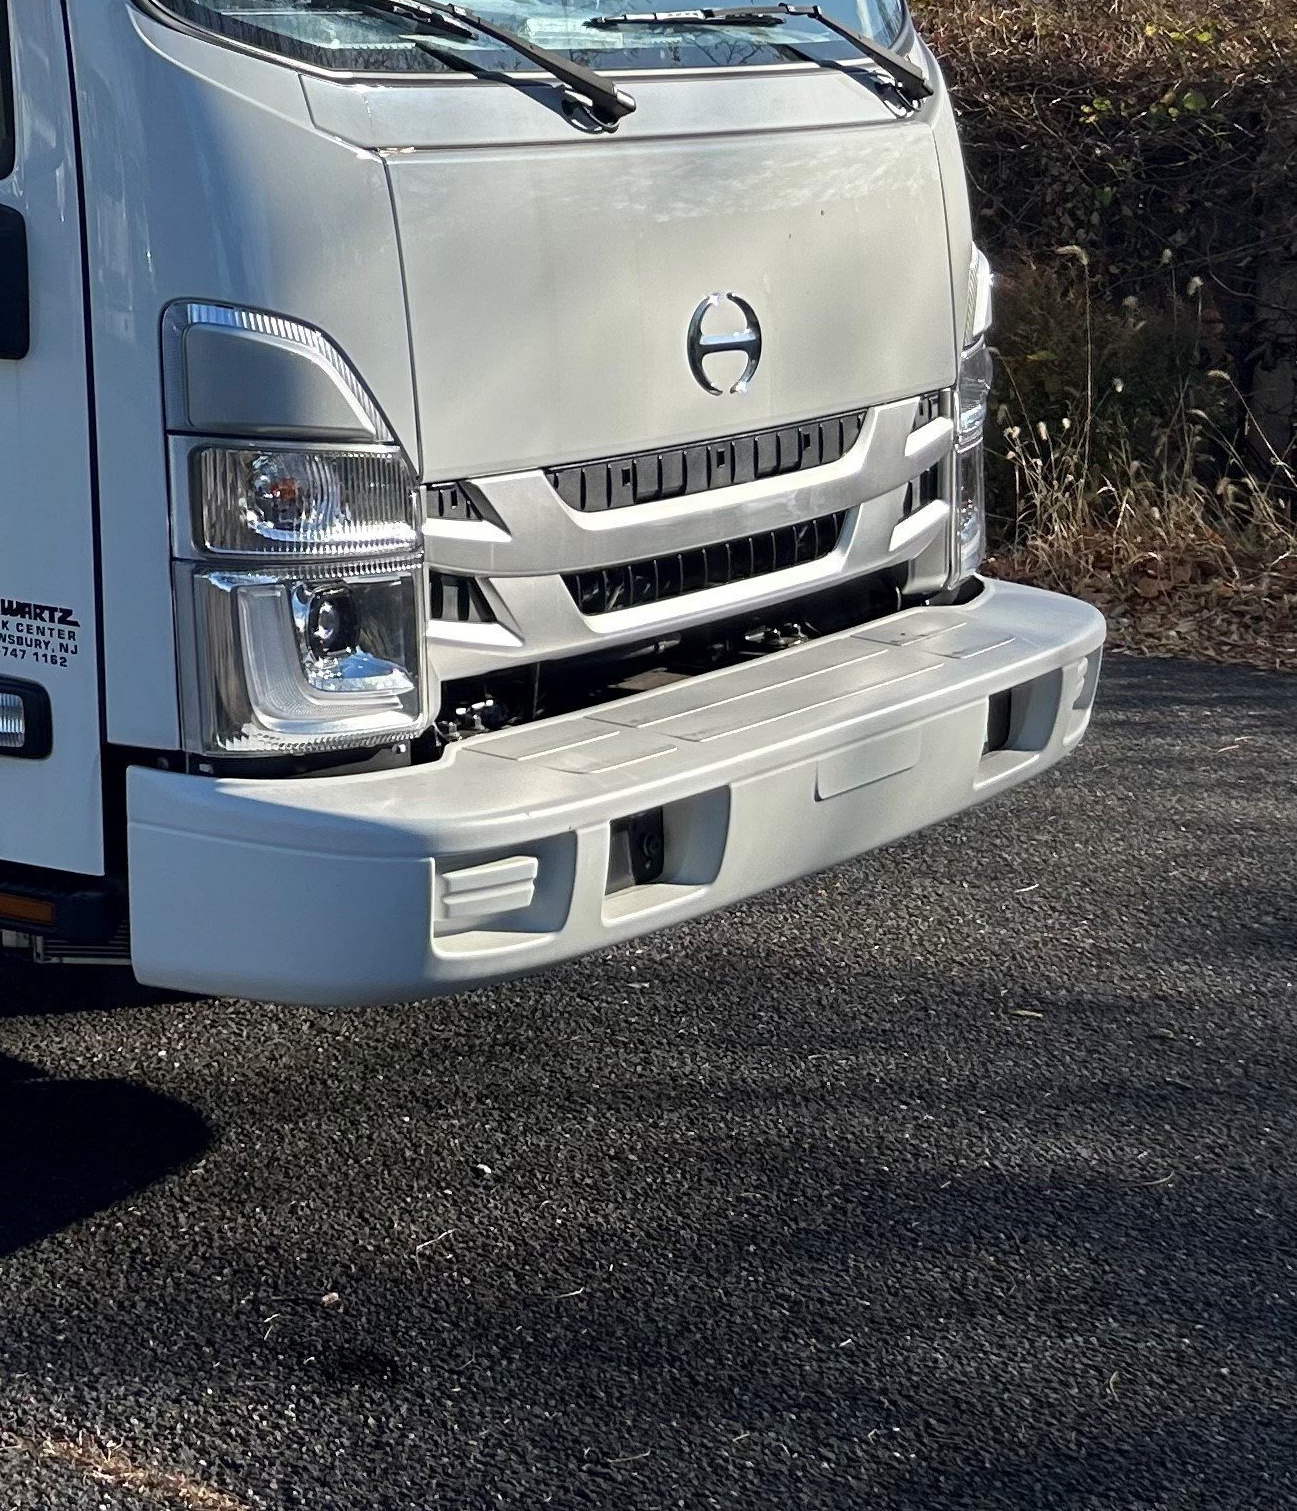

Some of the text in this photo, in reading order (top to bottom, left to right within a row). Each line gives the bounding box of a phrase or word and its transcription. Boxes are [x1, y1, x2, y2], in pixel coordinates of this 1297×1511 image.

[16, 622, 76, 642] CENTER
[59, 642, 78, 655] NJ
[33, 652, 68, 668] 1162
